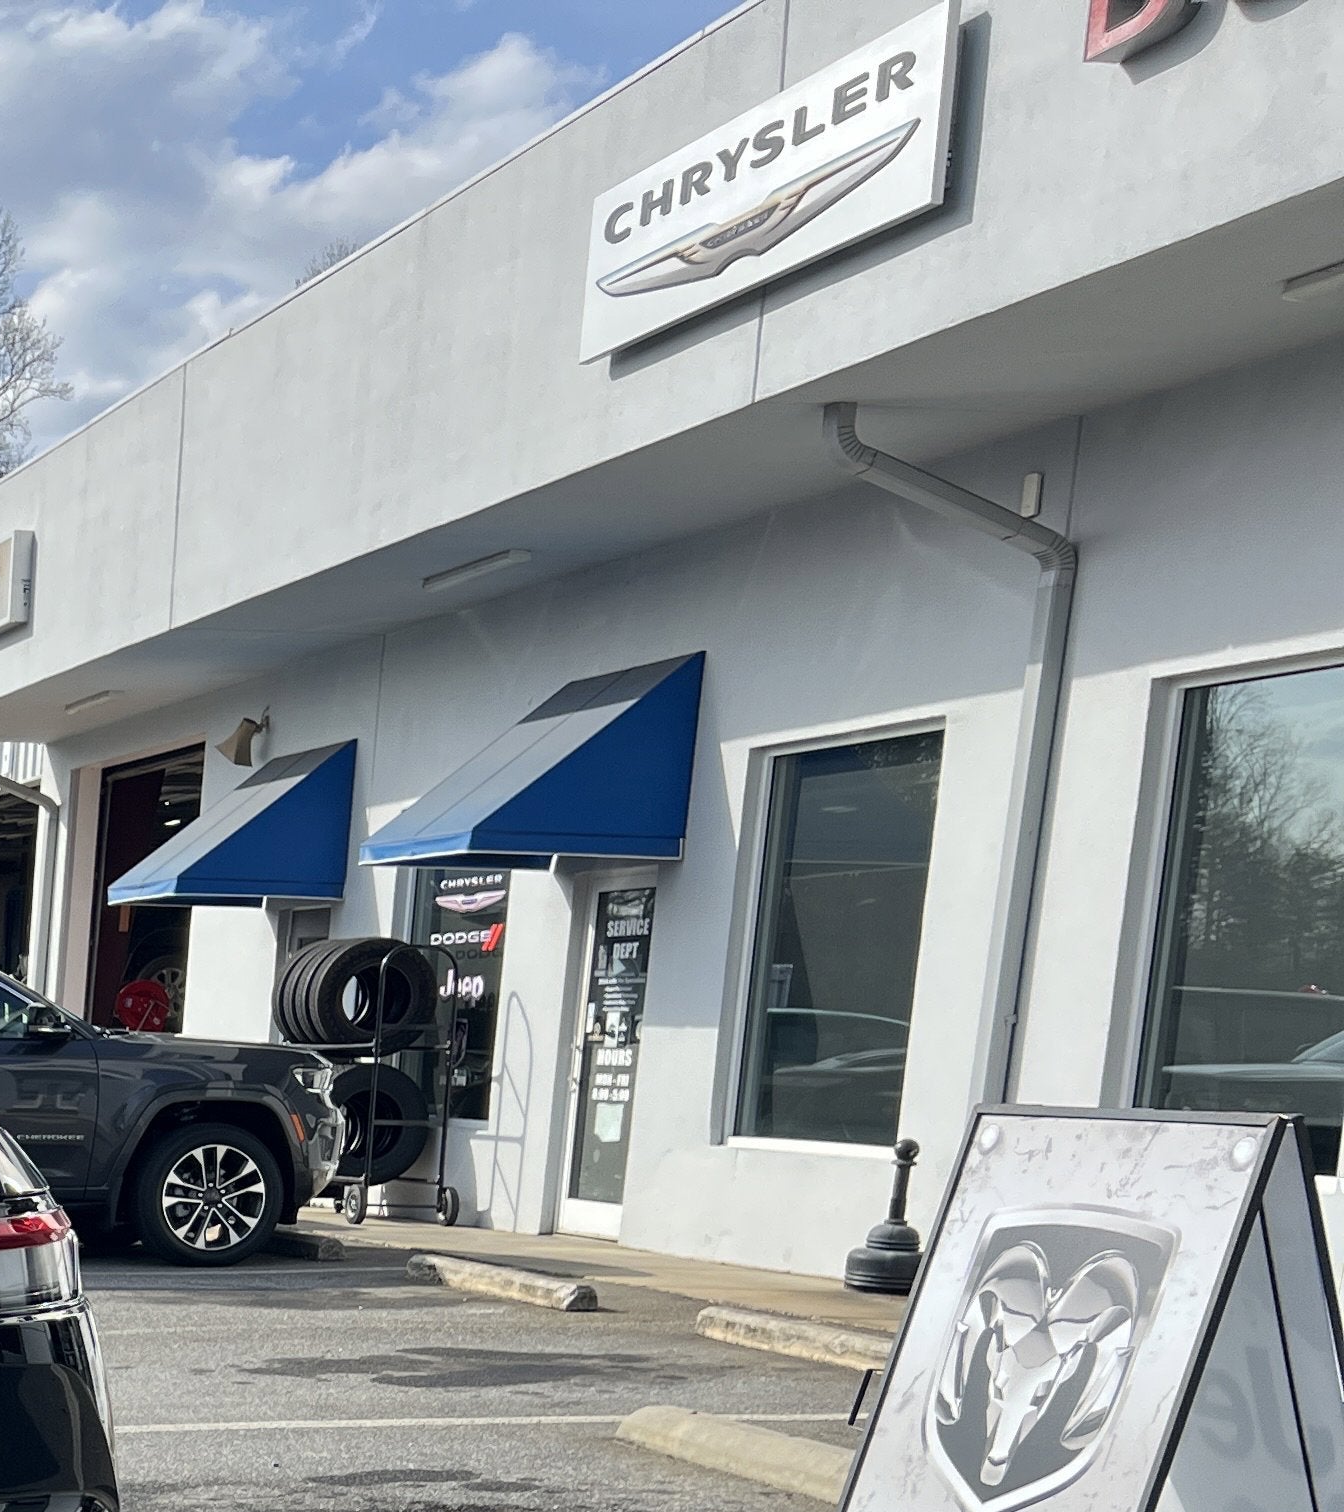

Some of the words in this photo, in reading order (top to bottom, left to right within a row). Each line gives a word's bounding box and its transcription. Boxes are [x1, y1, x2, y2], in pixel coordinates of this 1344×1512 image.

[603, 50, 918, 246] CHRYSLER
[439, 873, 503, 890] CHRYSLER
[606, 917, 650, 938] SERVICE
[429, 929, 492, 946] DODGE
[612, 941, 640, 960] DEPT
[596, 1048, 633, 1067] HOURS
